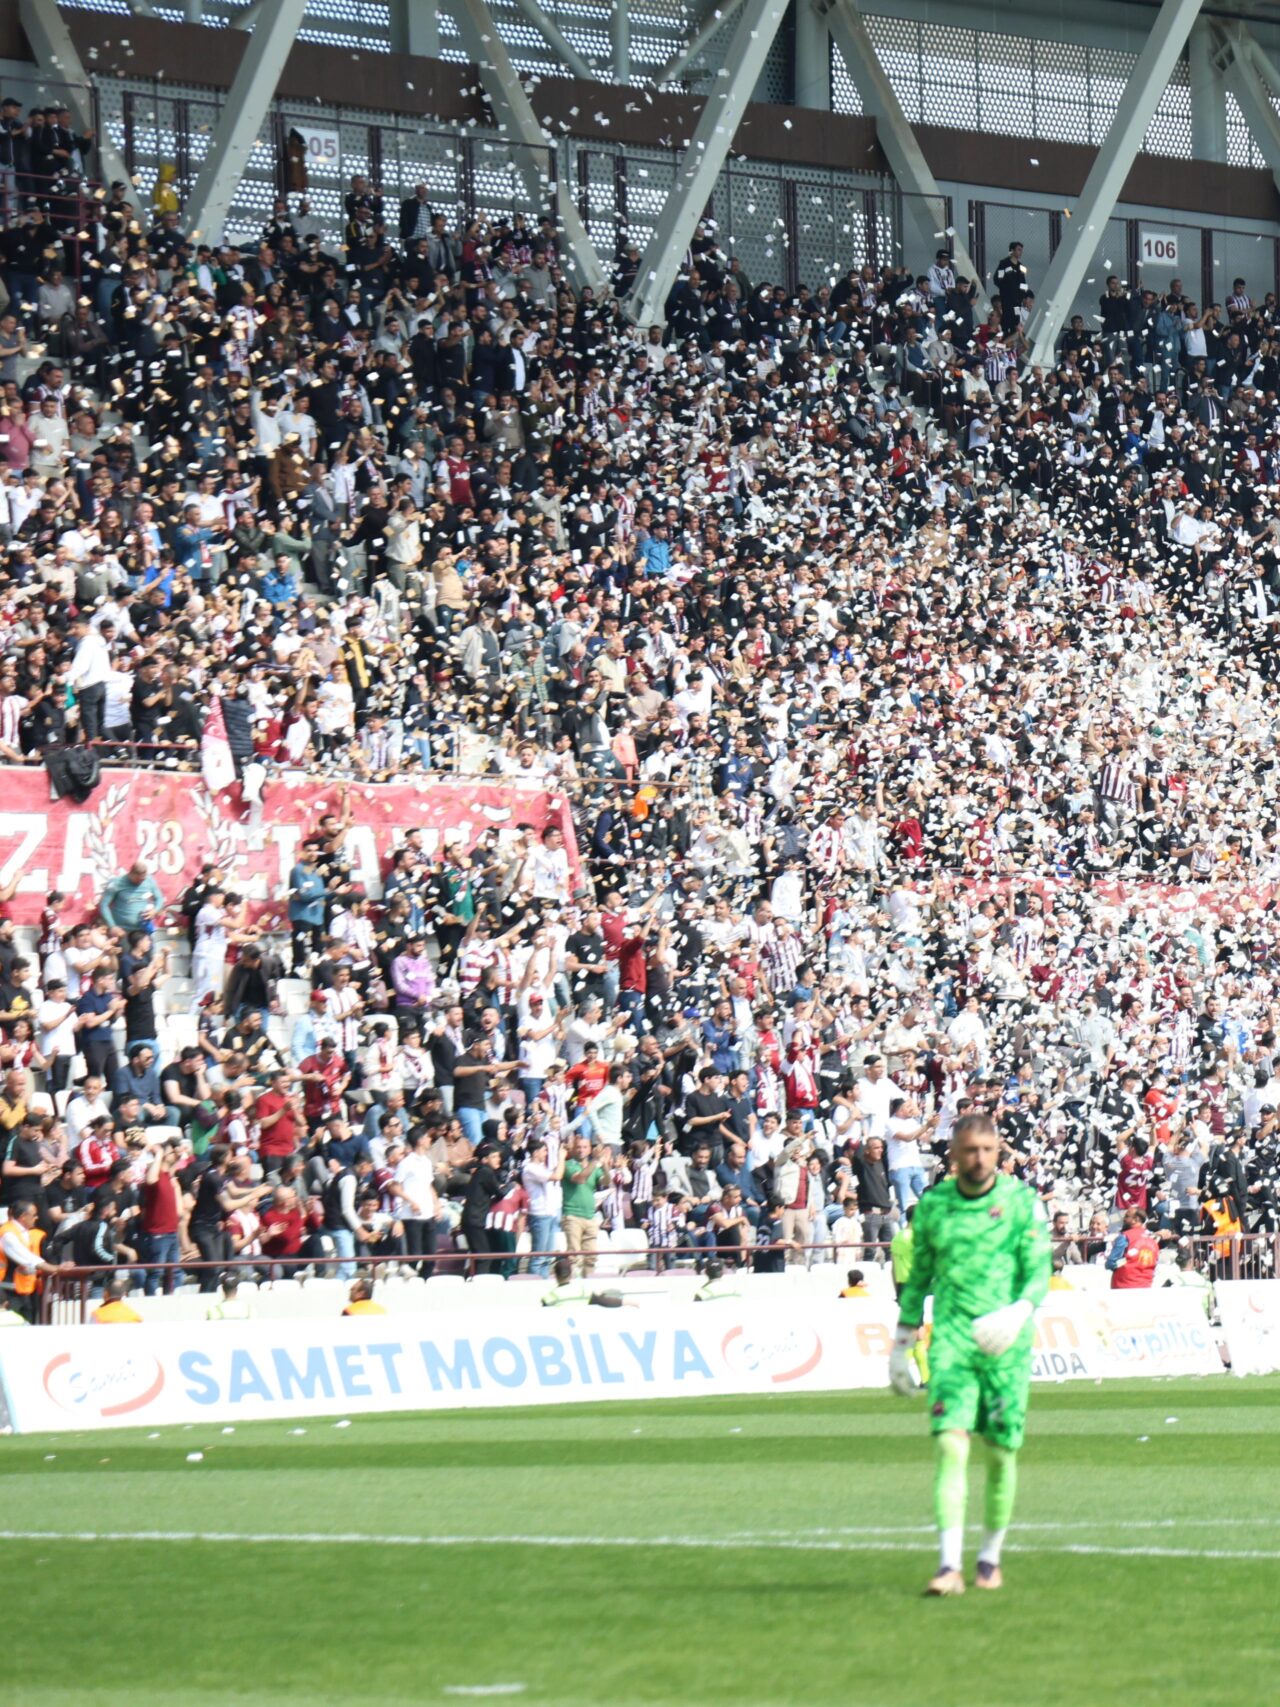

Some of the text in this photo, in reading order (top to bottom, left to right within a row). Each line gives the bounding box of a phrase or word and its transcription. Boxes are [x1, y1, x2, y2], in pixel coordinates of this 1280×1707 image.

[308, 136, 338, 158] 05
[1144, 239, 1176, 259] 106
[136, 819, 185, 875] 23
[178, 1317, 715, 1405] SAMET MOBİLYA
